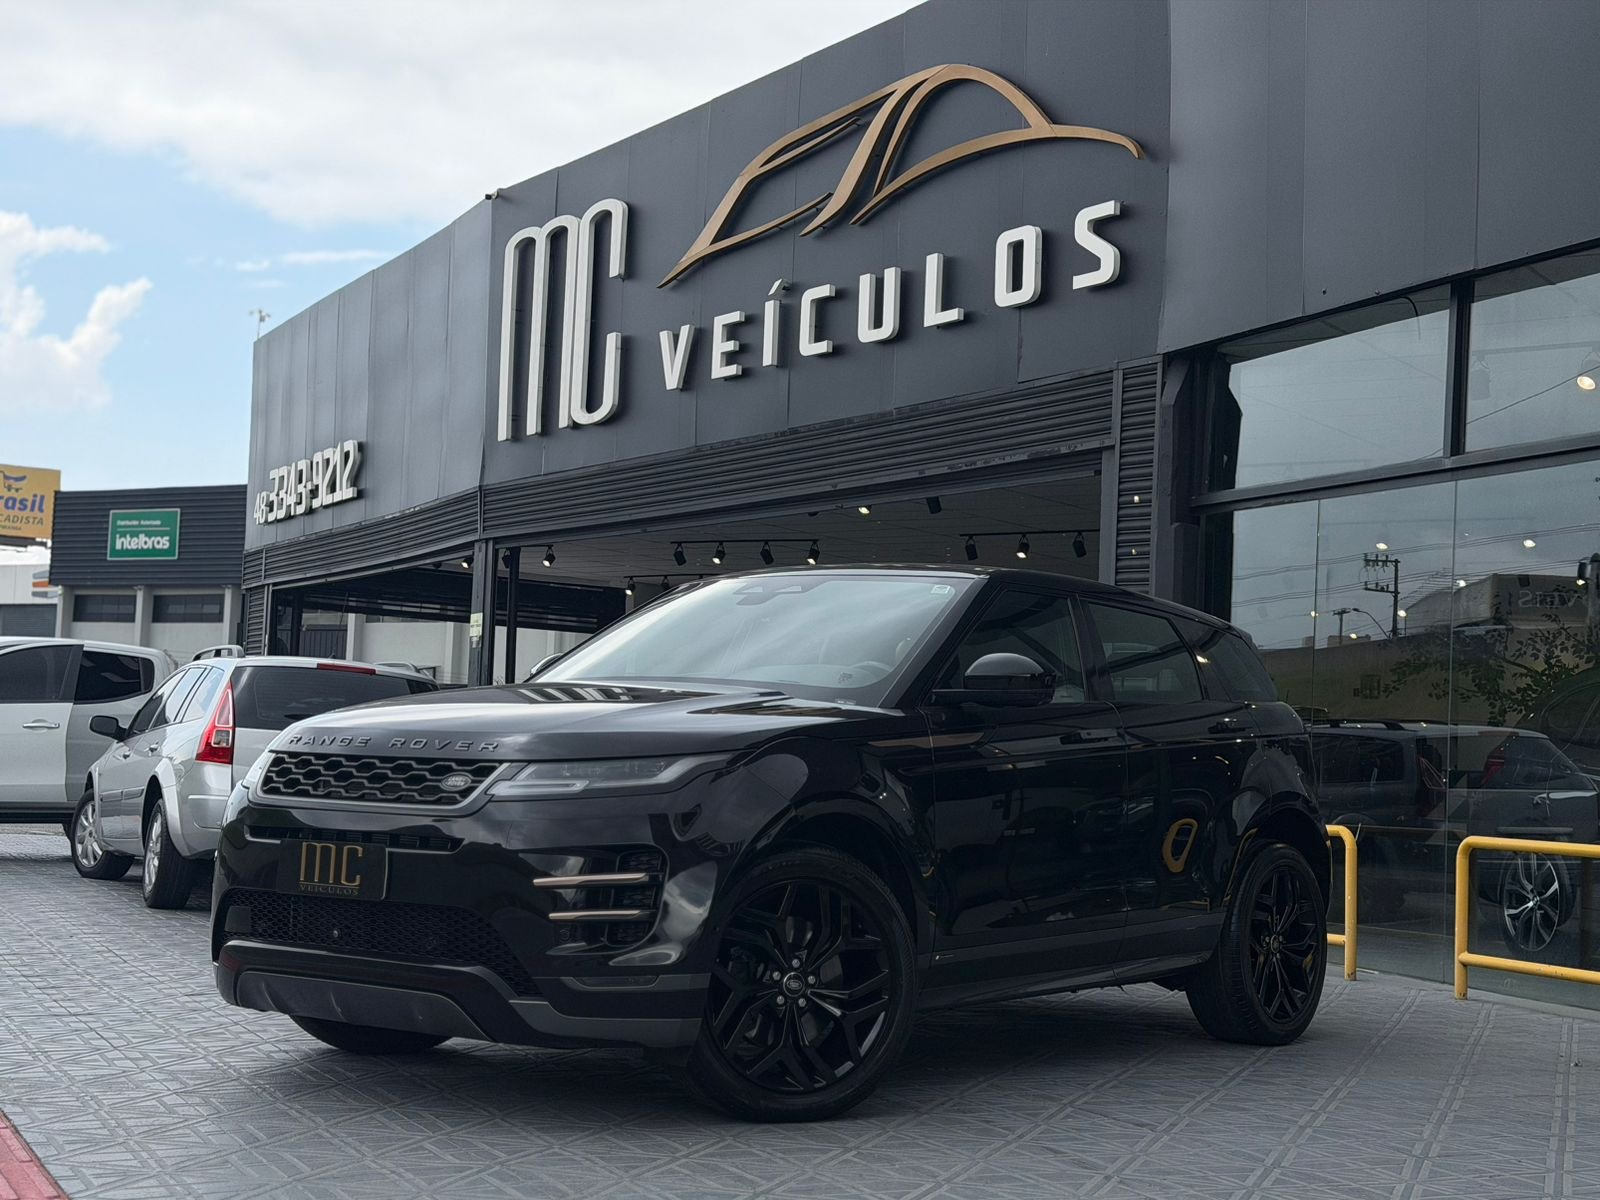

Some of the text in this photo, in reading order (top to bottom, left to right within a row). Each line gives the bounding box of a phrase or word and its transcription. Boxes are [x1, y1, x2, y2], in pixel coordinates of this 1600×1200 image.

[497, 198, 1123, 442] MC VEÍCULOS
[254, 439, 359, 526] 48 3343-9212
[115, 532, 171, 551] intelbras
[288, 735, 500, 752] RANGE ROVER
[299, 841, 364, 886] MC
